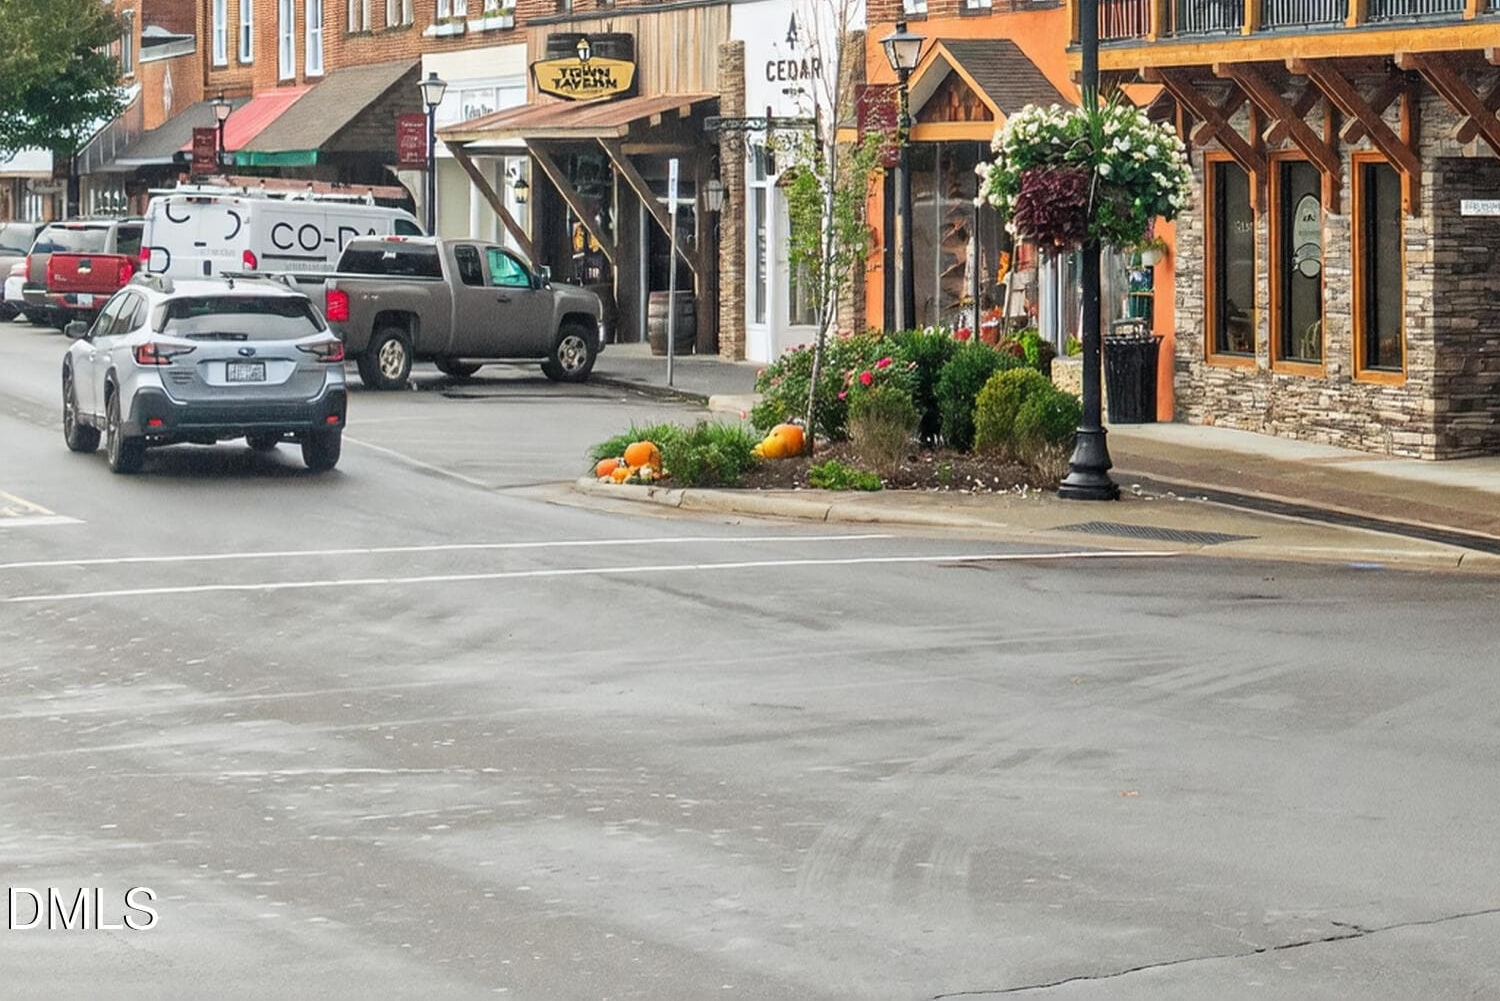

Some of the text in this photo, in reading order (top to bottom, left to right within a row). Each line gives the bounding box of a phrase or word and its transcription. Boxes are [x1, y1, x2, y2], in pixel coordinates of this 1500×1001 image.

[559, 64, 610, 78] TOWN
[766, 57, 821, 82] CEDAR
[552, 78, 617, 90] TAVERN
